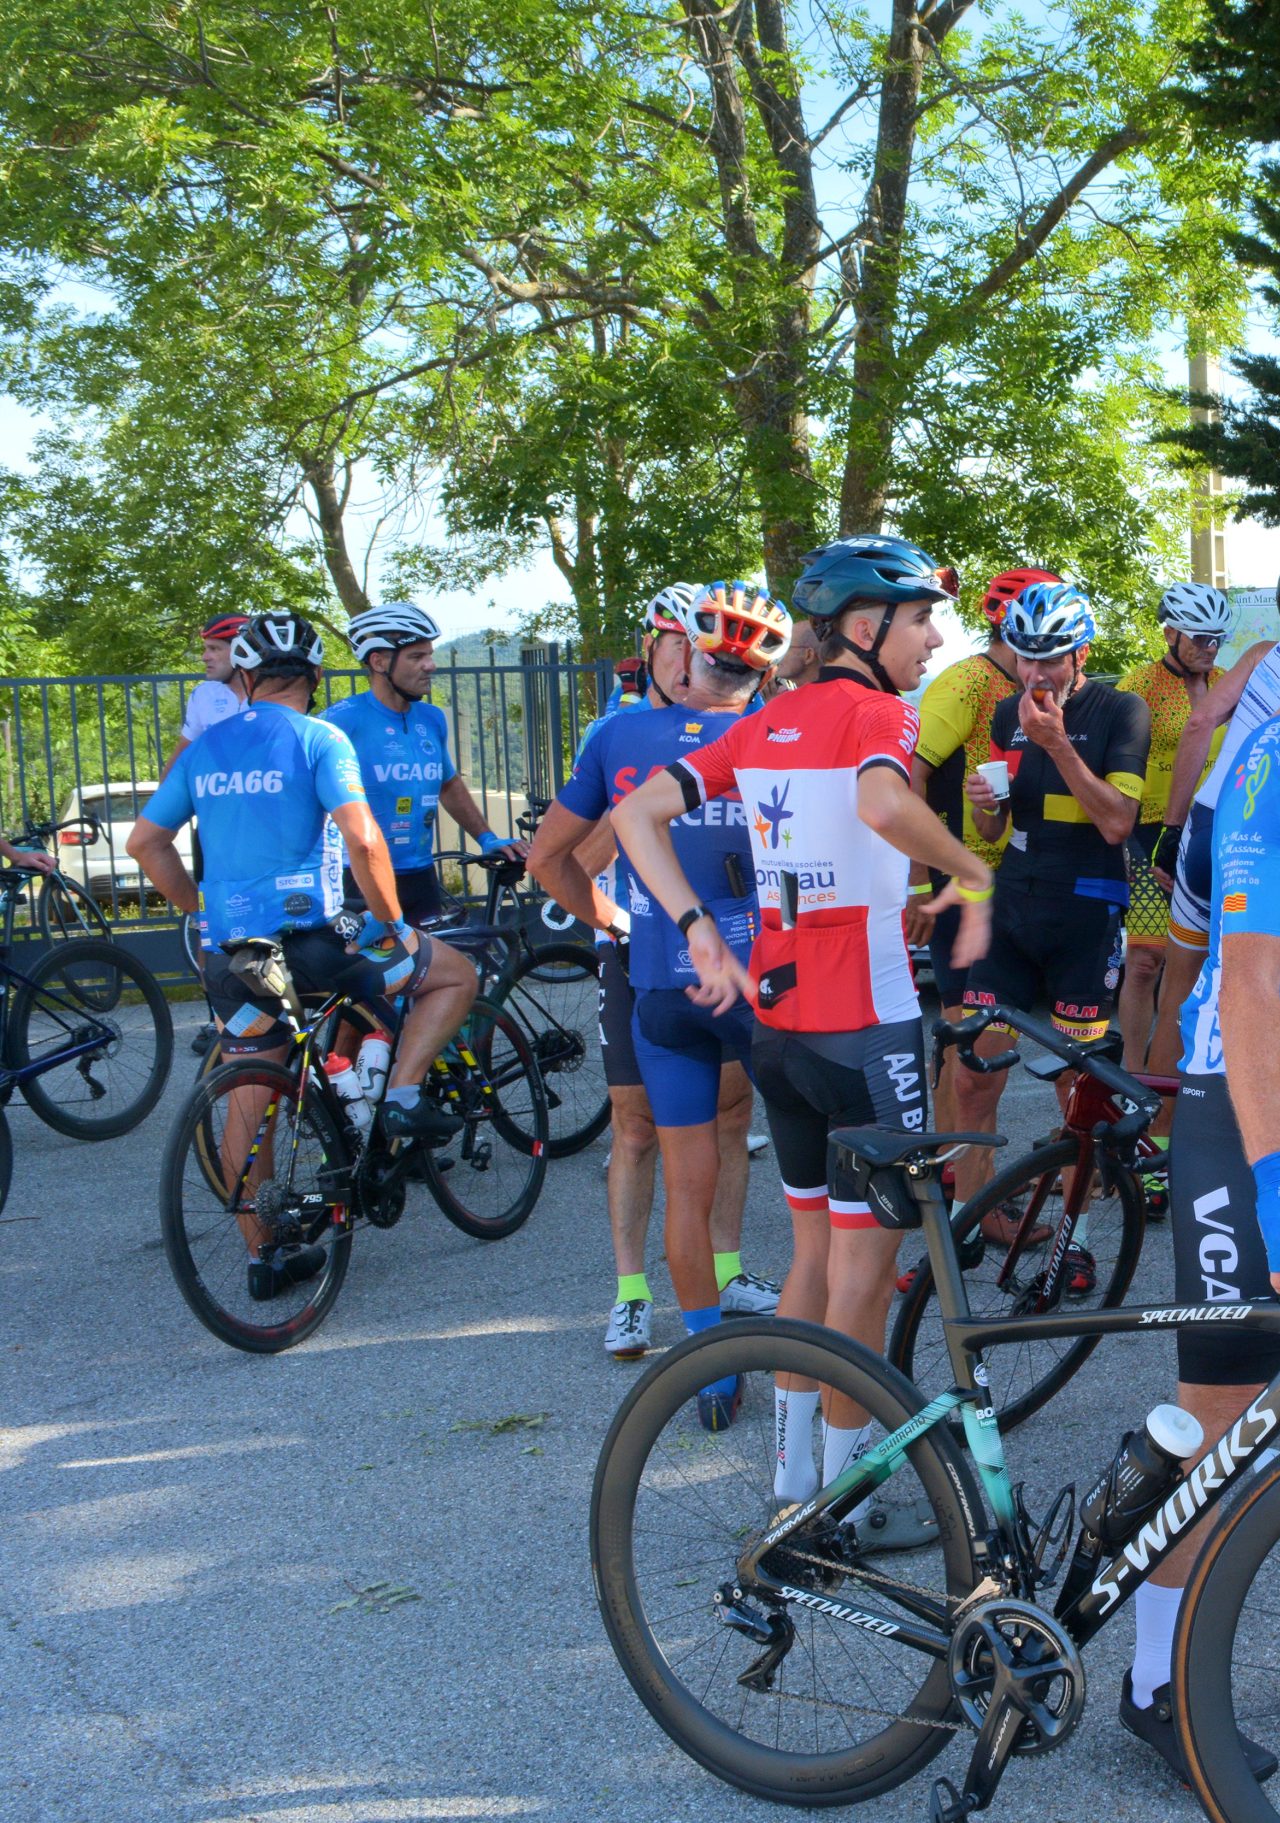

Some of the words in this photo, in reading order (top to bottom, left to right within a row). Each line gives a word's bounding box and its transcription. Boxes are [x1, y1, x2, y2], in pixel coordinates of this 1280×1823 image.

[195, 770, 284, 798] VCA66
[883, 1053, 921, 1102] AAJ
[302, 1193, 323, 1204] 795
[1042, 1213, 1072, 1297] SPECIALIZED
[1138, 1305, 1253, 1324] SPECIALIZED
[877, 1415, 928, 1457] SHIMANO
[764, 1501, 817, 1545] TARMAC
[1092, 1388, 1277, 1615] S-WORKS
[774, 1586, 900, 1637] SPECIALIZED
